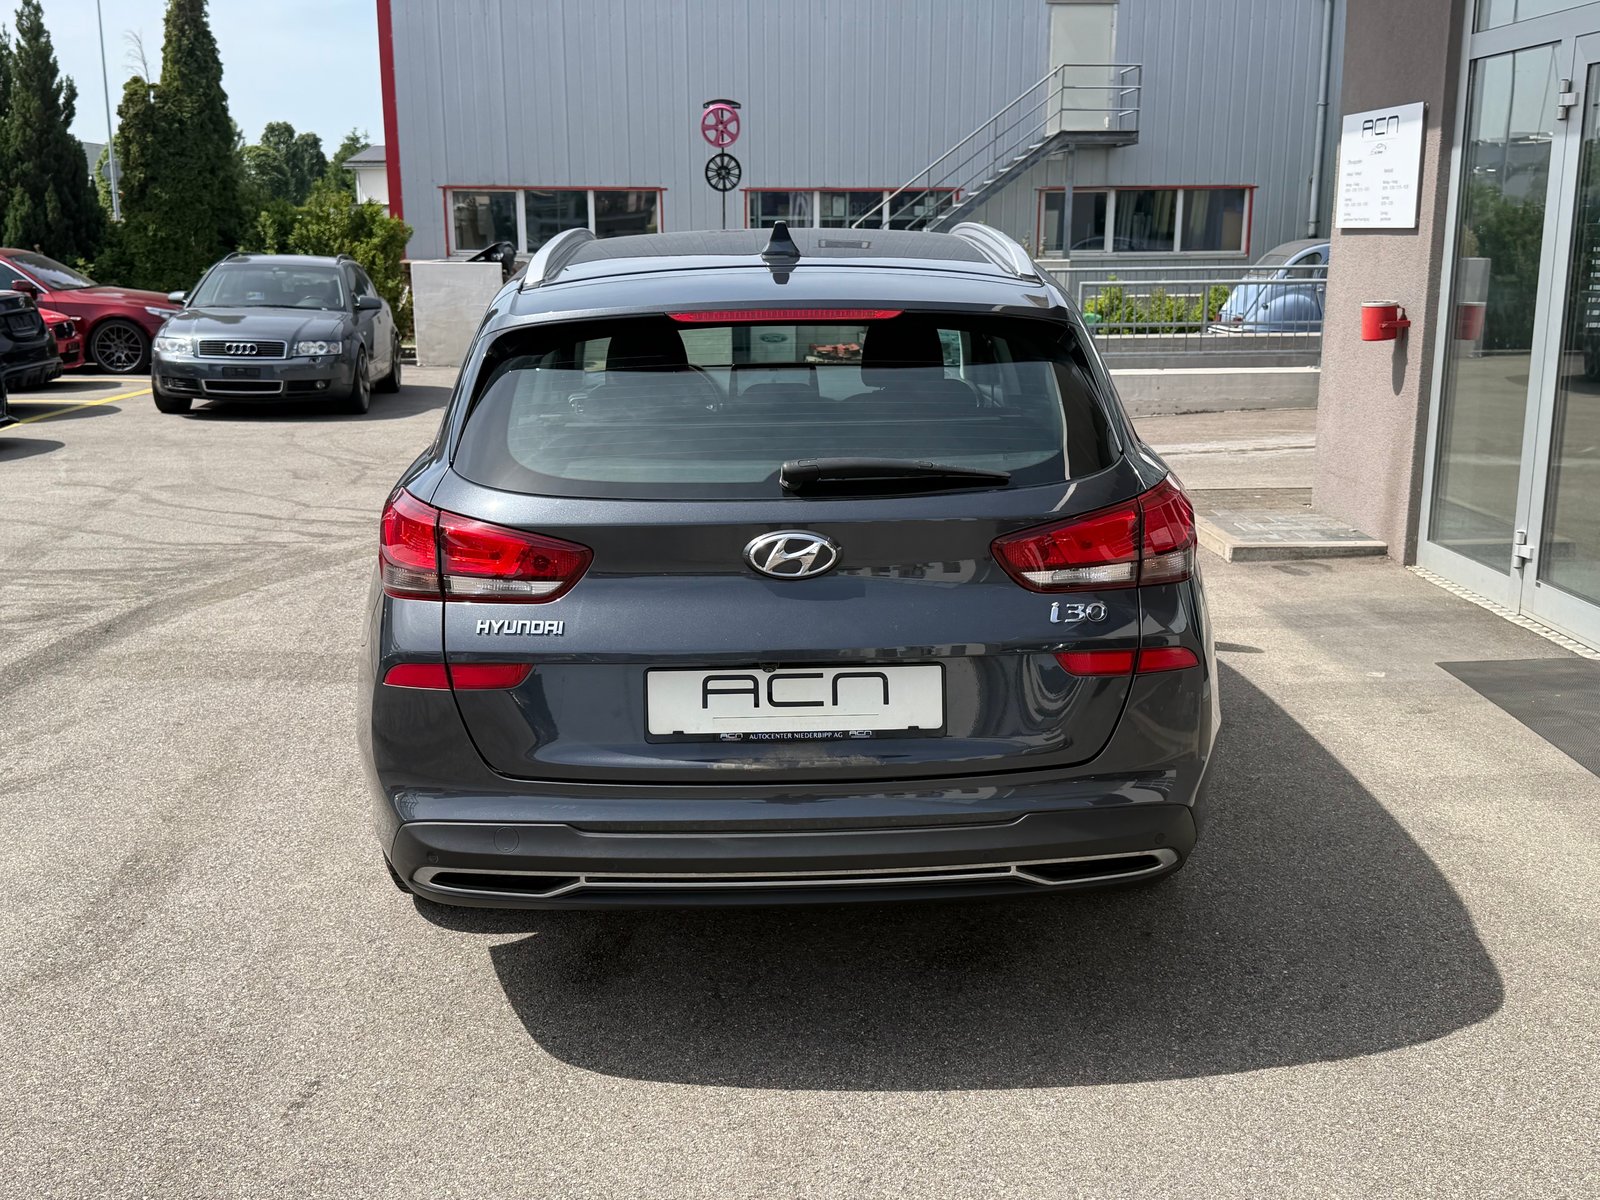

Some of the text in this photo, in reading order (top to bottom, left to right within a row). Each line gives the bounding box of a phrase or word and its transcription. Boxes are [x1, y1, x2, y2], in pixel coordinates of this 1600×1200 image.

[1361, 115, 1399, 137] ACN
[1050, 601, 1108, 623] i30
[475, 619, 565, 636] HYUNDAI
[702, 671, 890, 709] ACN
[749, 732, 793, 740] AUTOCENTER
[793, 731, 832, 739] NIEDERBIPP
